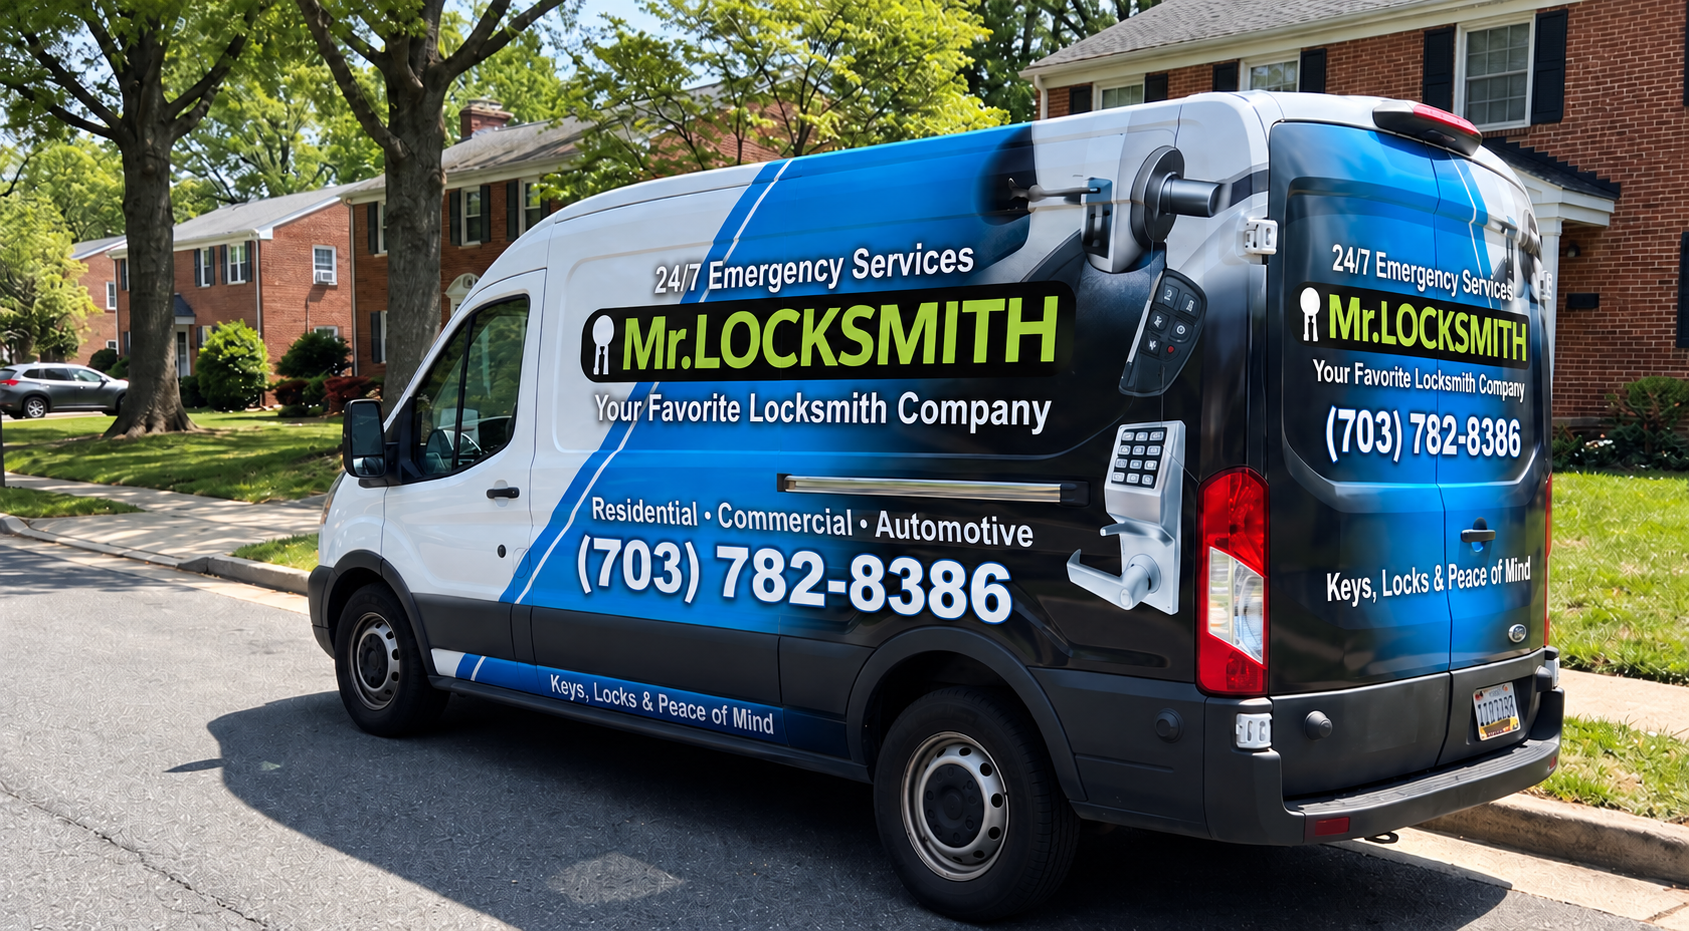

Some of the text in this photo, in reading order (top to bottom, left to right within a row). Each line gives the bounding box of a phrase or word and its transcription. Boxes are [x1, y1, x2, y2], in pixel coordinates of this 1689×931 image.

[654, 243, 974, 294] 24/7 Emergency Services
[1332, 244, 1513, 301] 24/7 Emergency Services
[622, 296, 1059, 370] Mr.LOCKSMITH
[1329, 294, 1527, 362] Mr.LOCKSMITH
[1313, 358, 1525, 402] Your Favorite Locksmith Company
[595, 391, 1052, 436] Your Favorite Locksmith Company
[1326, 405, 1521, 463] (703) 782-8386
[592, 497, 1034, 547] Residential Commercial Automotive
[578, 535, 1013, 623] (703) 782-8386
[1326, 556, 1531, 607] Keys, Locks & Peace of Mind
[550, 674, 774, 734] Keys, Locks & Peace of Mind
